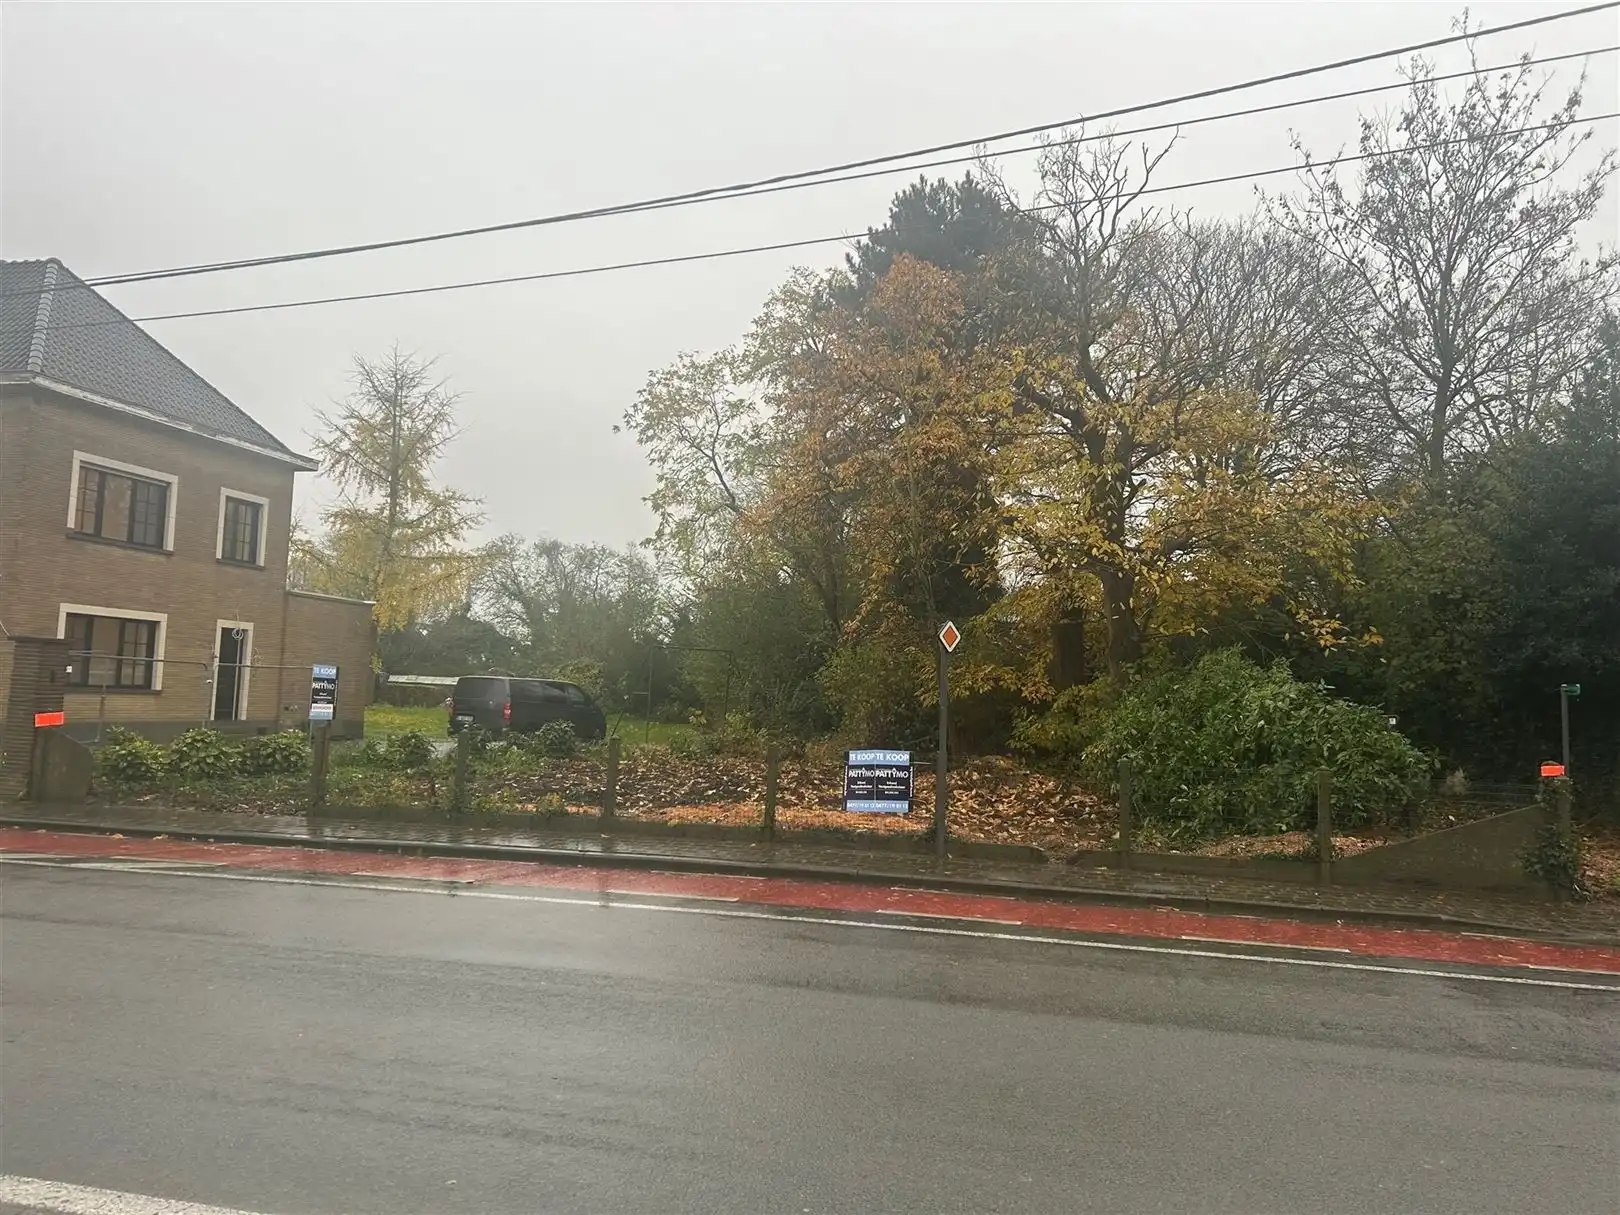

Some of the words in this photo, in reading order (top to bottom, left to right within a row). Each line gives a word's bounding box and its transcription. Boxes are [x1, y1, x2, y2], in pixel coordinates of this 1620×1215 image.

[857, 752, 874, 760] KOOP
[875, 752, 884, 760] TE
[886, 753, 909, 761] KOOP
